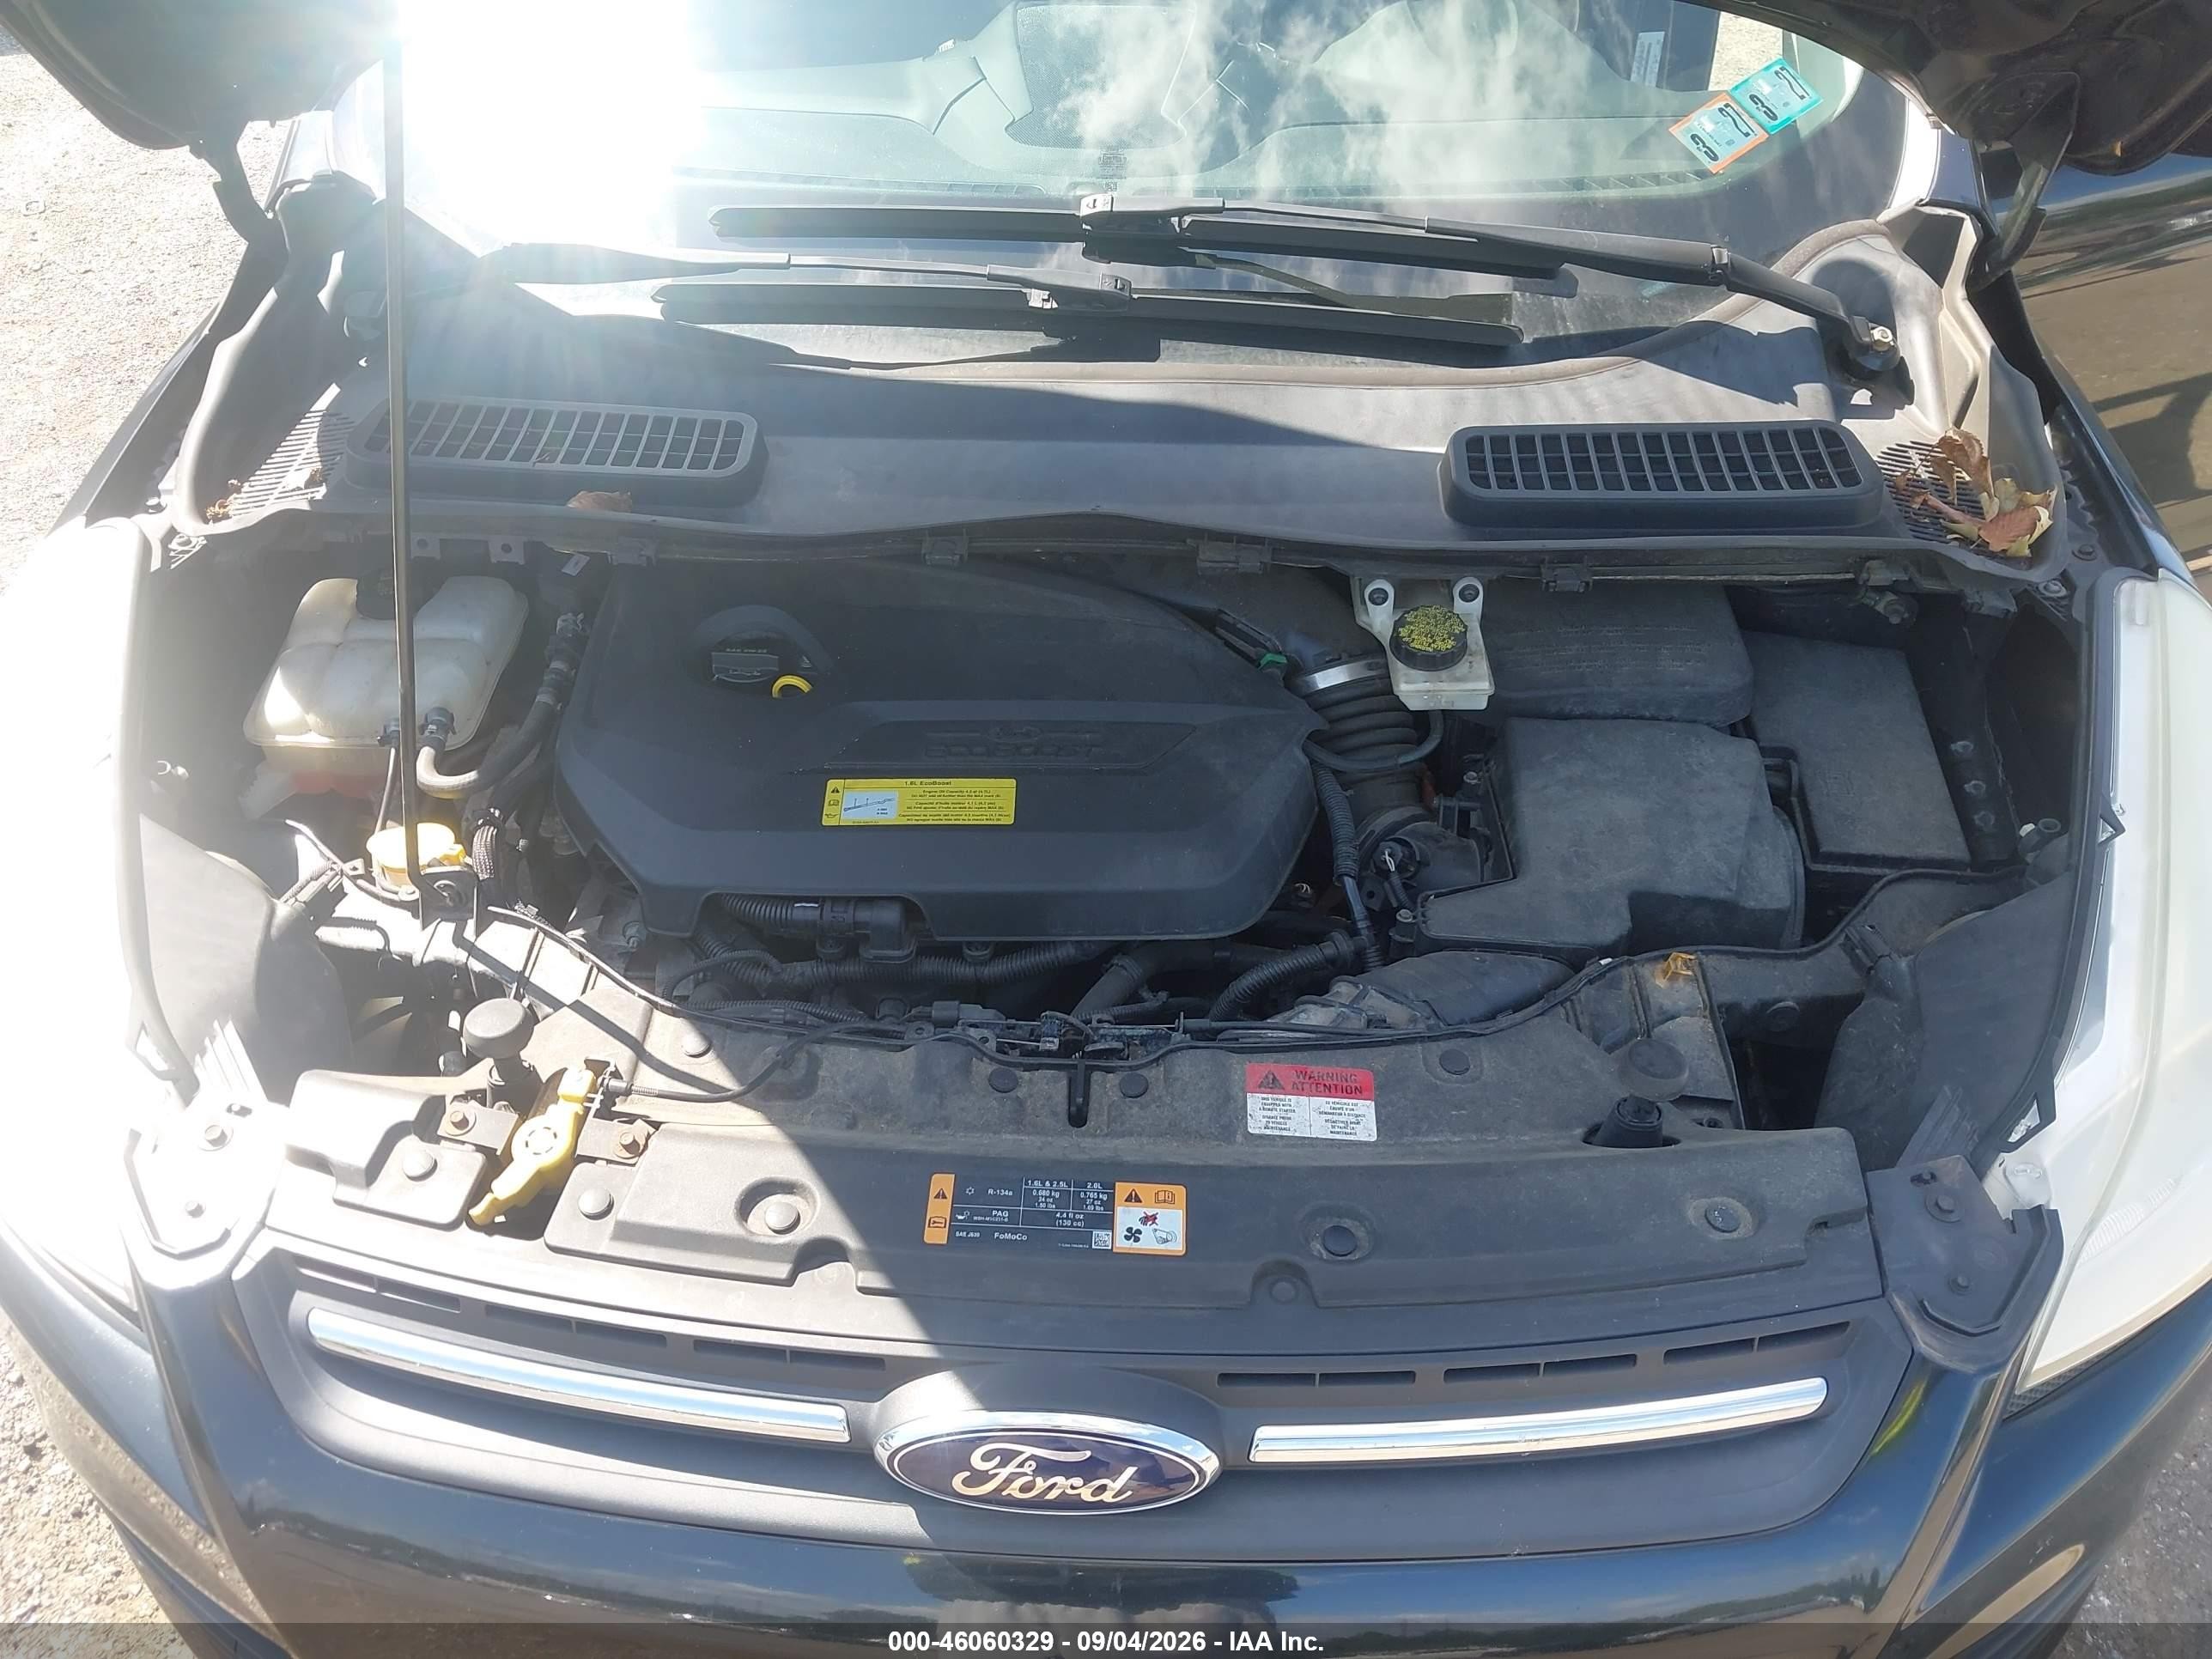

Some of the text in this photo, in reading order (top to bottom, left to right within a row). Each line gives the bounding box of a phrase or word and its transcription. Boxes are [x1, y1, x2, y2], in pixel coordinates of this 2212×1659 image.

[1295, 1068, 1358, 1084] WARNING
[1291, 1081, 1364, 1096] ATTENTION
[1051, 1190, 1060, 1199] kg
[1098, 1192, 1108, 1200] kg
[994, 1232, 1028, 1241] FoMoCo
[951, 1442, 1139, 1504] Ford
